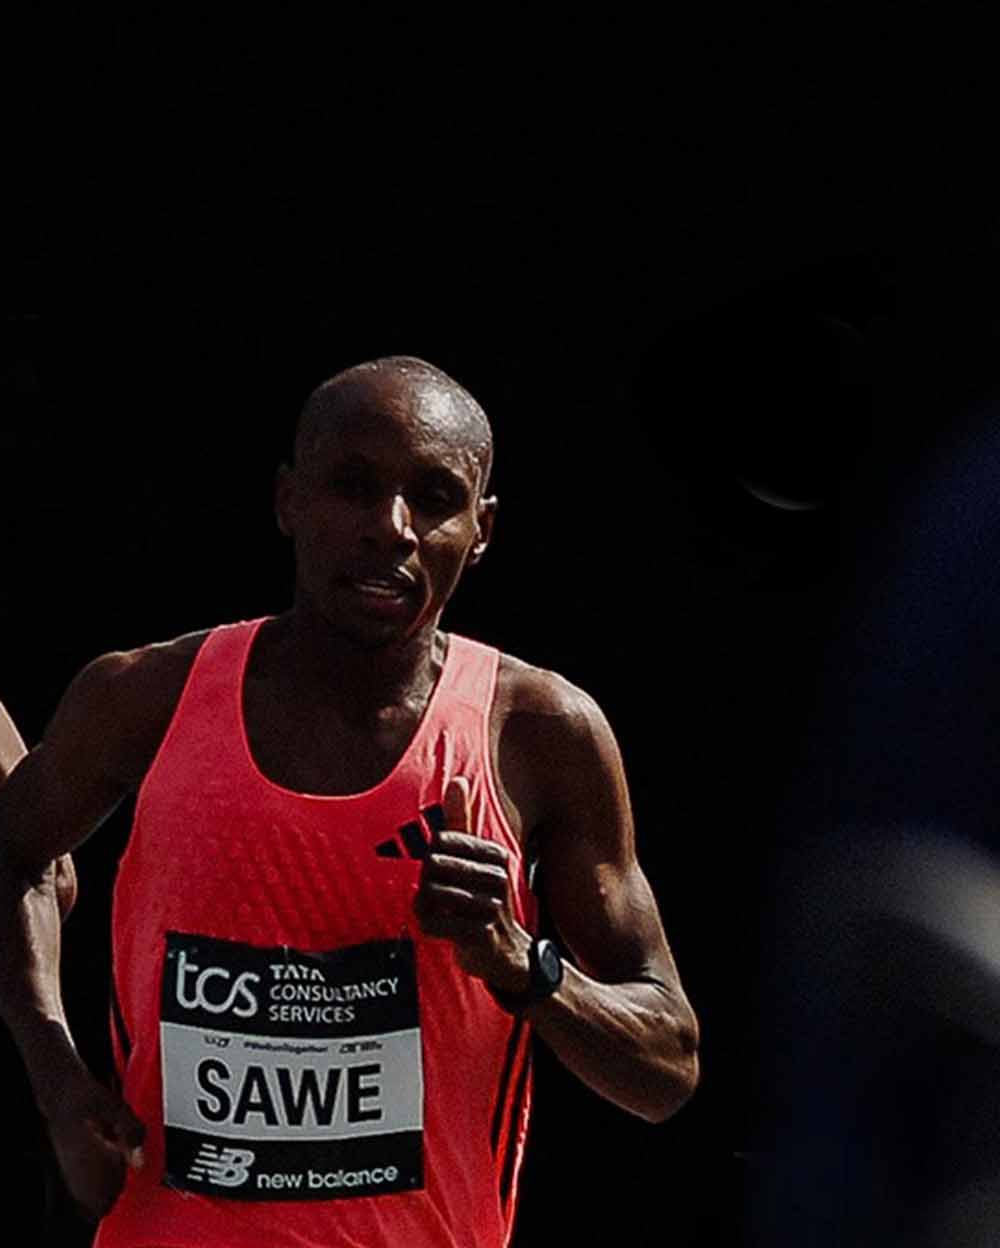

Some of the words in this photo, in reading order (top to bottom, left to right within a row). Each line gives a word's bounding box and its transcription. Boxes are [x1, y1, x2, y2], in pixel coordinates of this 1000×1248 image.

[175, 950, 261, 1017] tcs
[269, 964, 325, 981] TATA
[269, 977, 399, 1001] CONSULTANCY
[268, 1005, 355, 1022] SERVICES
[196, 1057, 383, 1128] SAWE
[257, 1172, 303, 1189] new
[308, 1165, 398, 1189] balance
